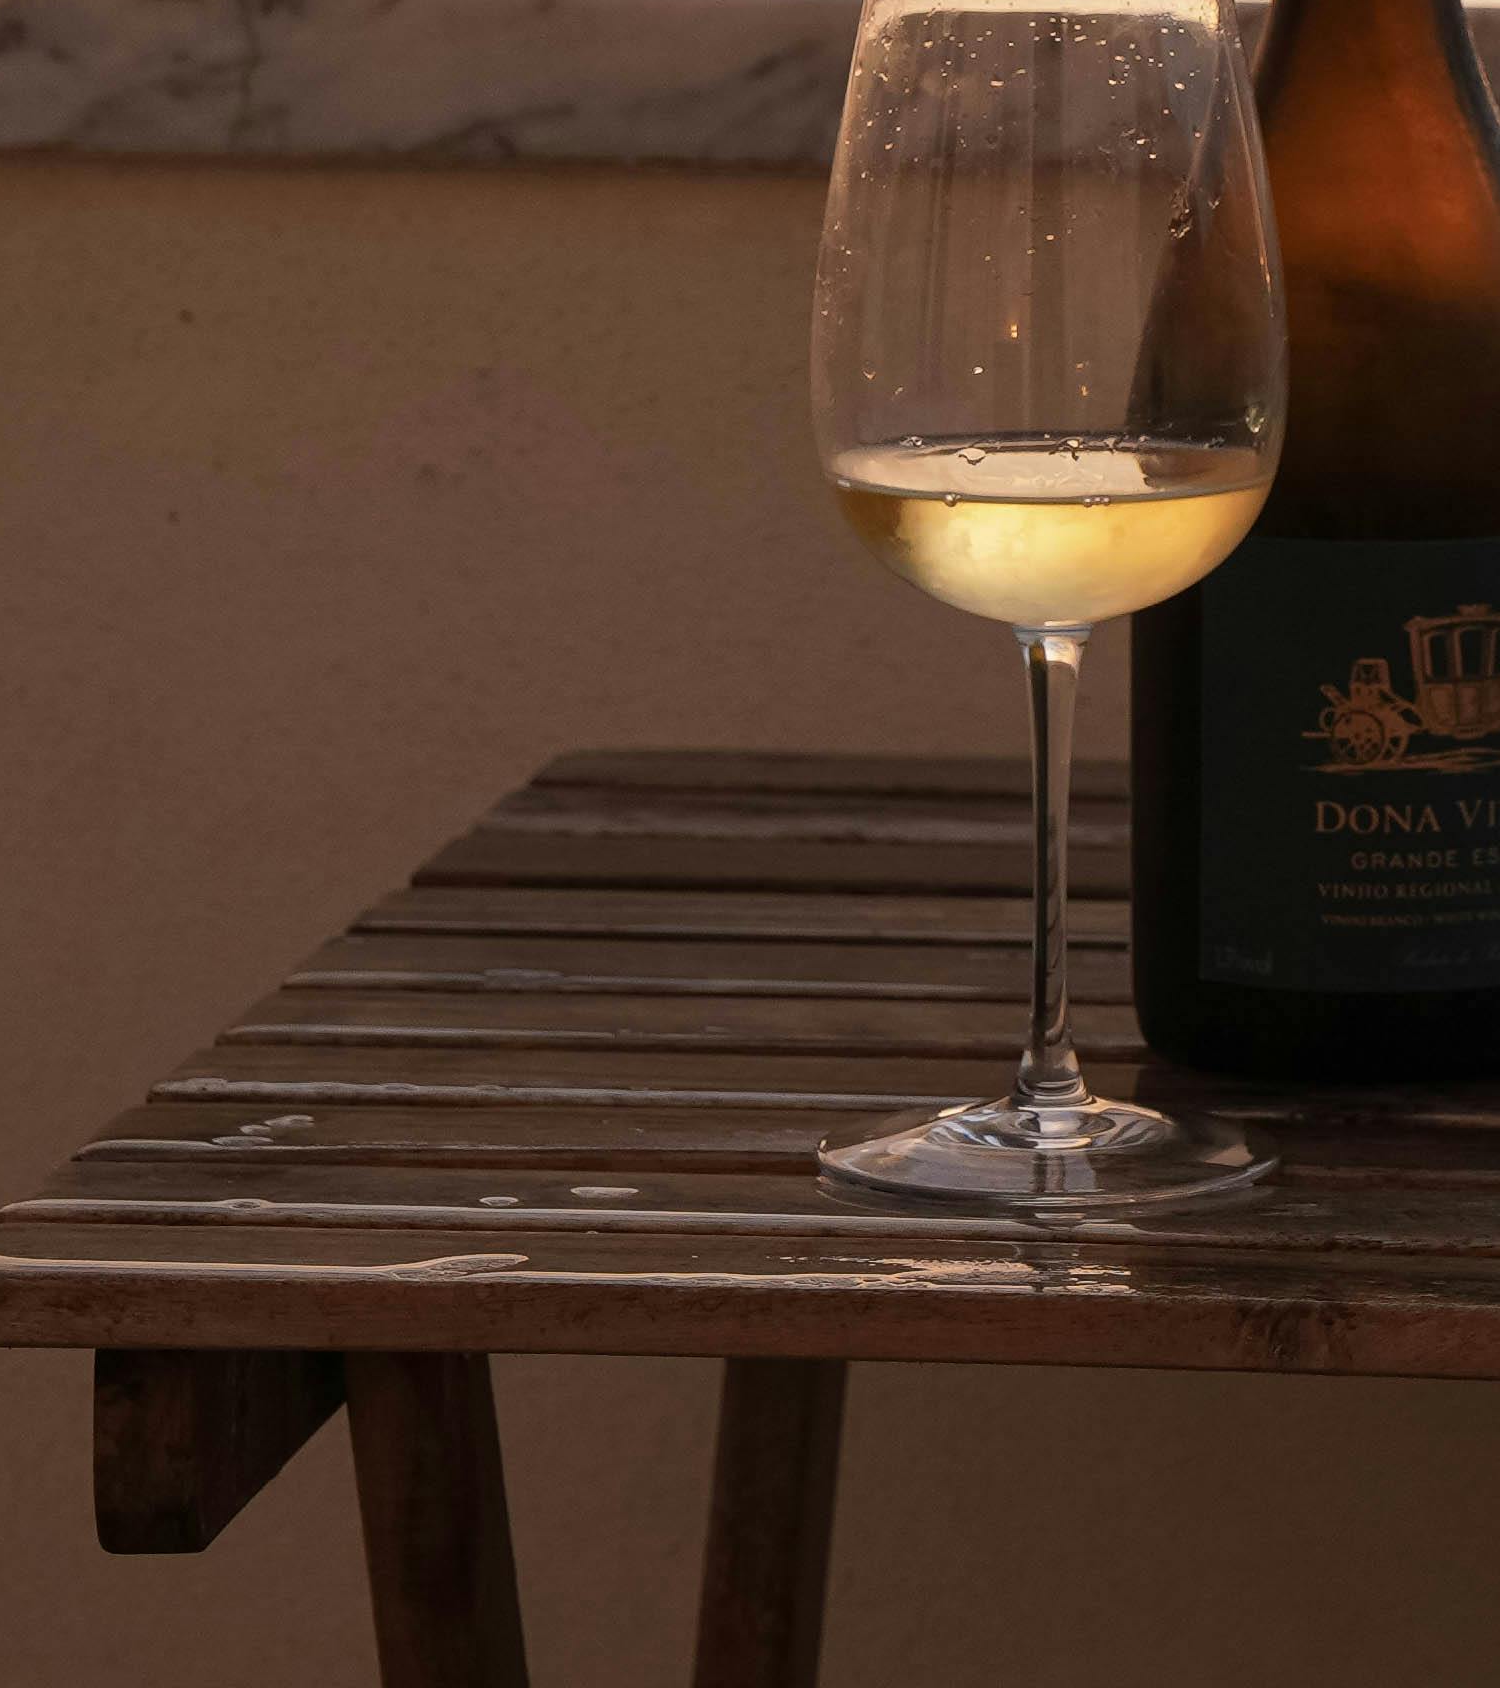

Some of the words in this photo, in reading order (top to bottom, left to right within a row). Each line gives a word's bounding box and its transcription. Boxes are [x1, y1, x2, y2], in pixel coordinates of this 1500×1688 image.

[1314, 800, 1442, 834] DONA
[1350, 848, 1459, 871] GRANDE
[1317, 881, 1389, 900] VINHO
[1395, 880, 1494, 899] REGIONAL
